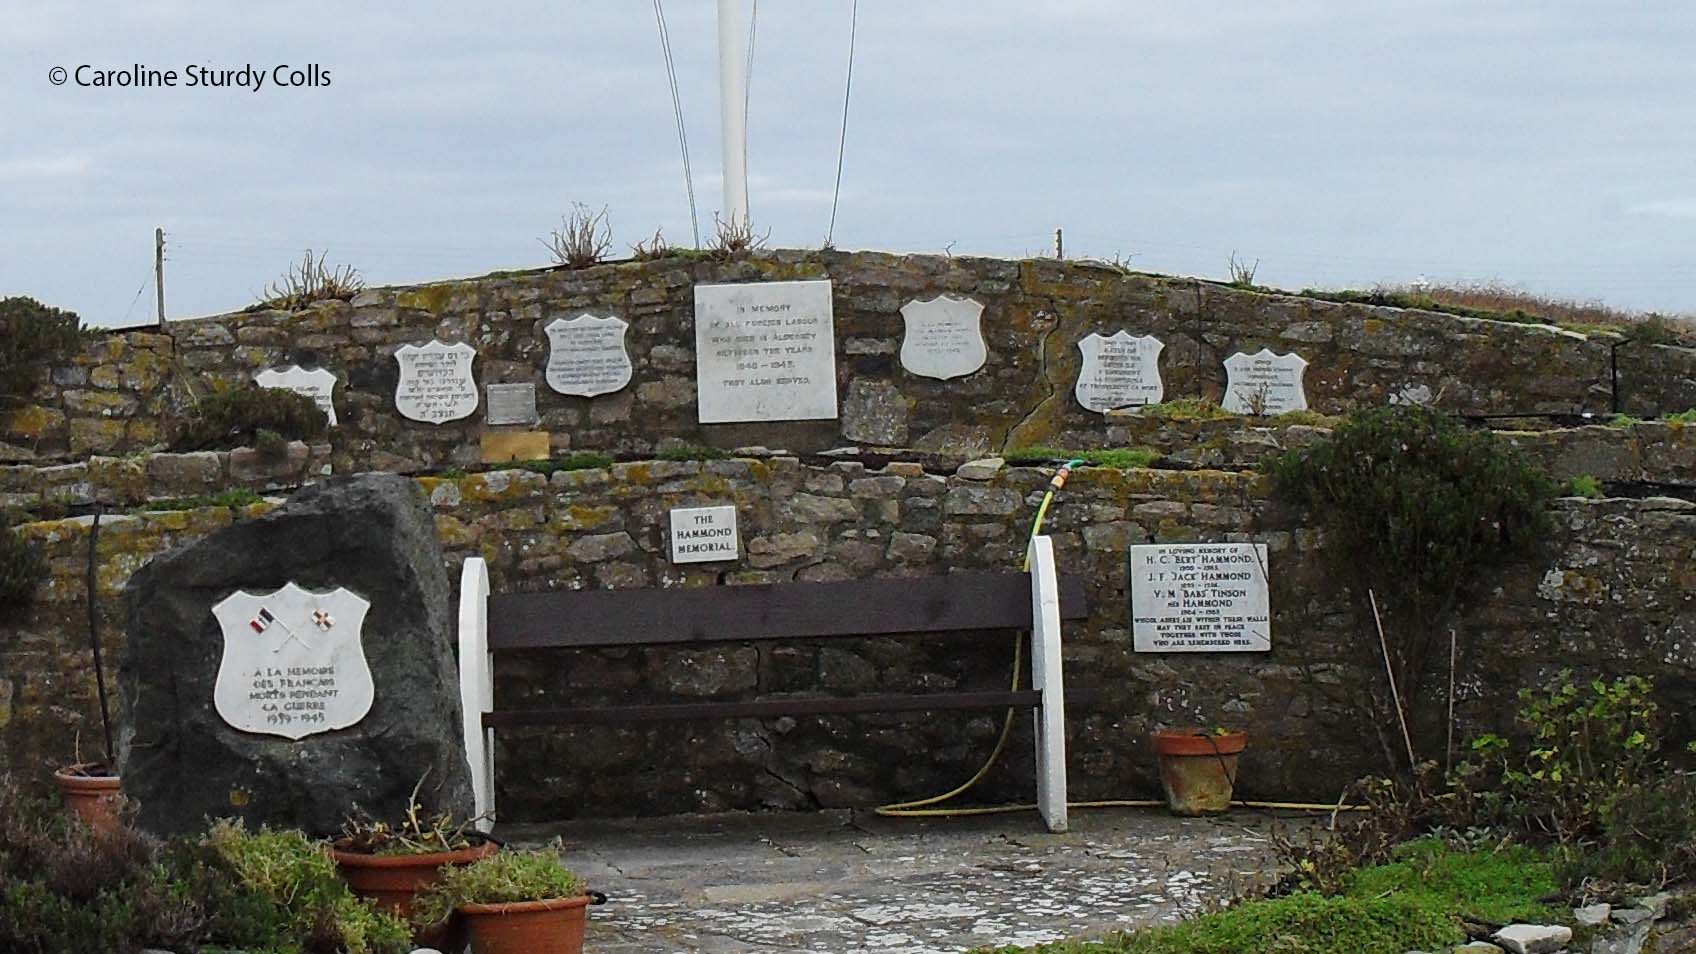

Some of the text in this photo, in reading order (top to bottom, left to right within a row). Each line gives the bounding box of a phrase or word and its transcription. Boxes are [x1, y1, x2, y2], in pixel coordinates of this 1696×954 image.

[737, 304, 791, 313] IN MEMORY
[785, 347, 813, 355] YEARS
[694, 515, 714, 524] THE
[677, 528, 732, 539] HAMMOND
[1146, 556, 1156, 564] H.
[1160, 555, 1170, 564] C.
[1148, 573, 1156, 581] J.
[1201, 572, 1251, 580] HAMMOND
[1154, 590, 1165, 598] V.
[1183, 599, 1232, 607] HAMMOND
[267, 668, 282, 676] LA
[253, 679, 274, 688] DES
[249, 689, 339, 700] MORTS PENDANT
[262, 701, 325, 711] LA GUERRE
